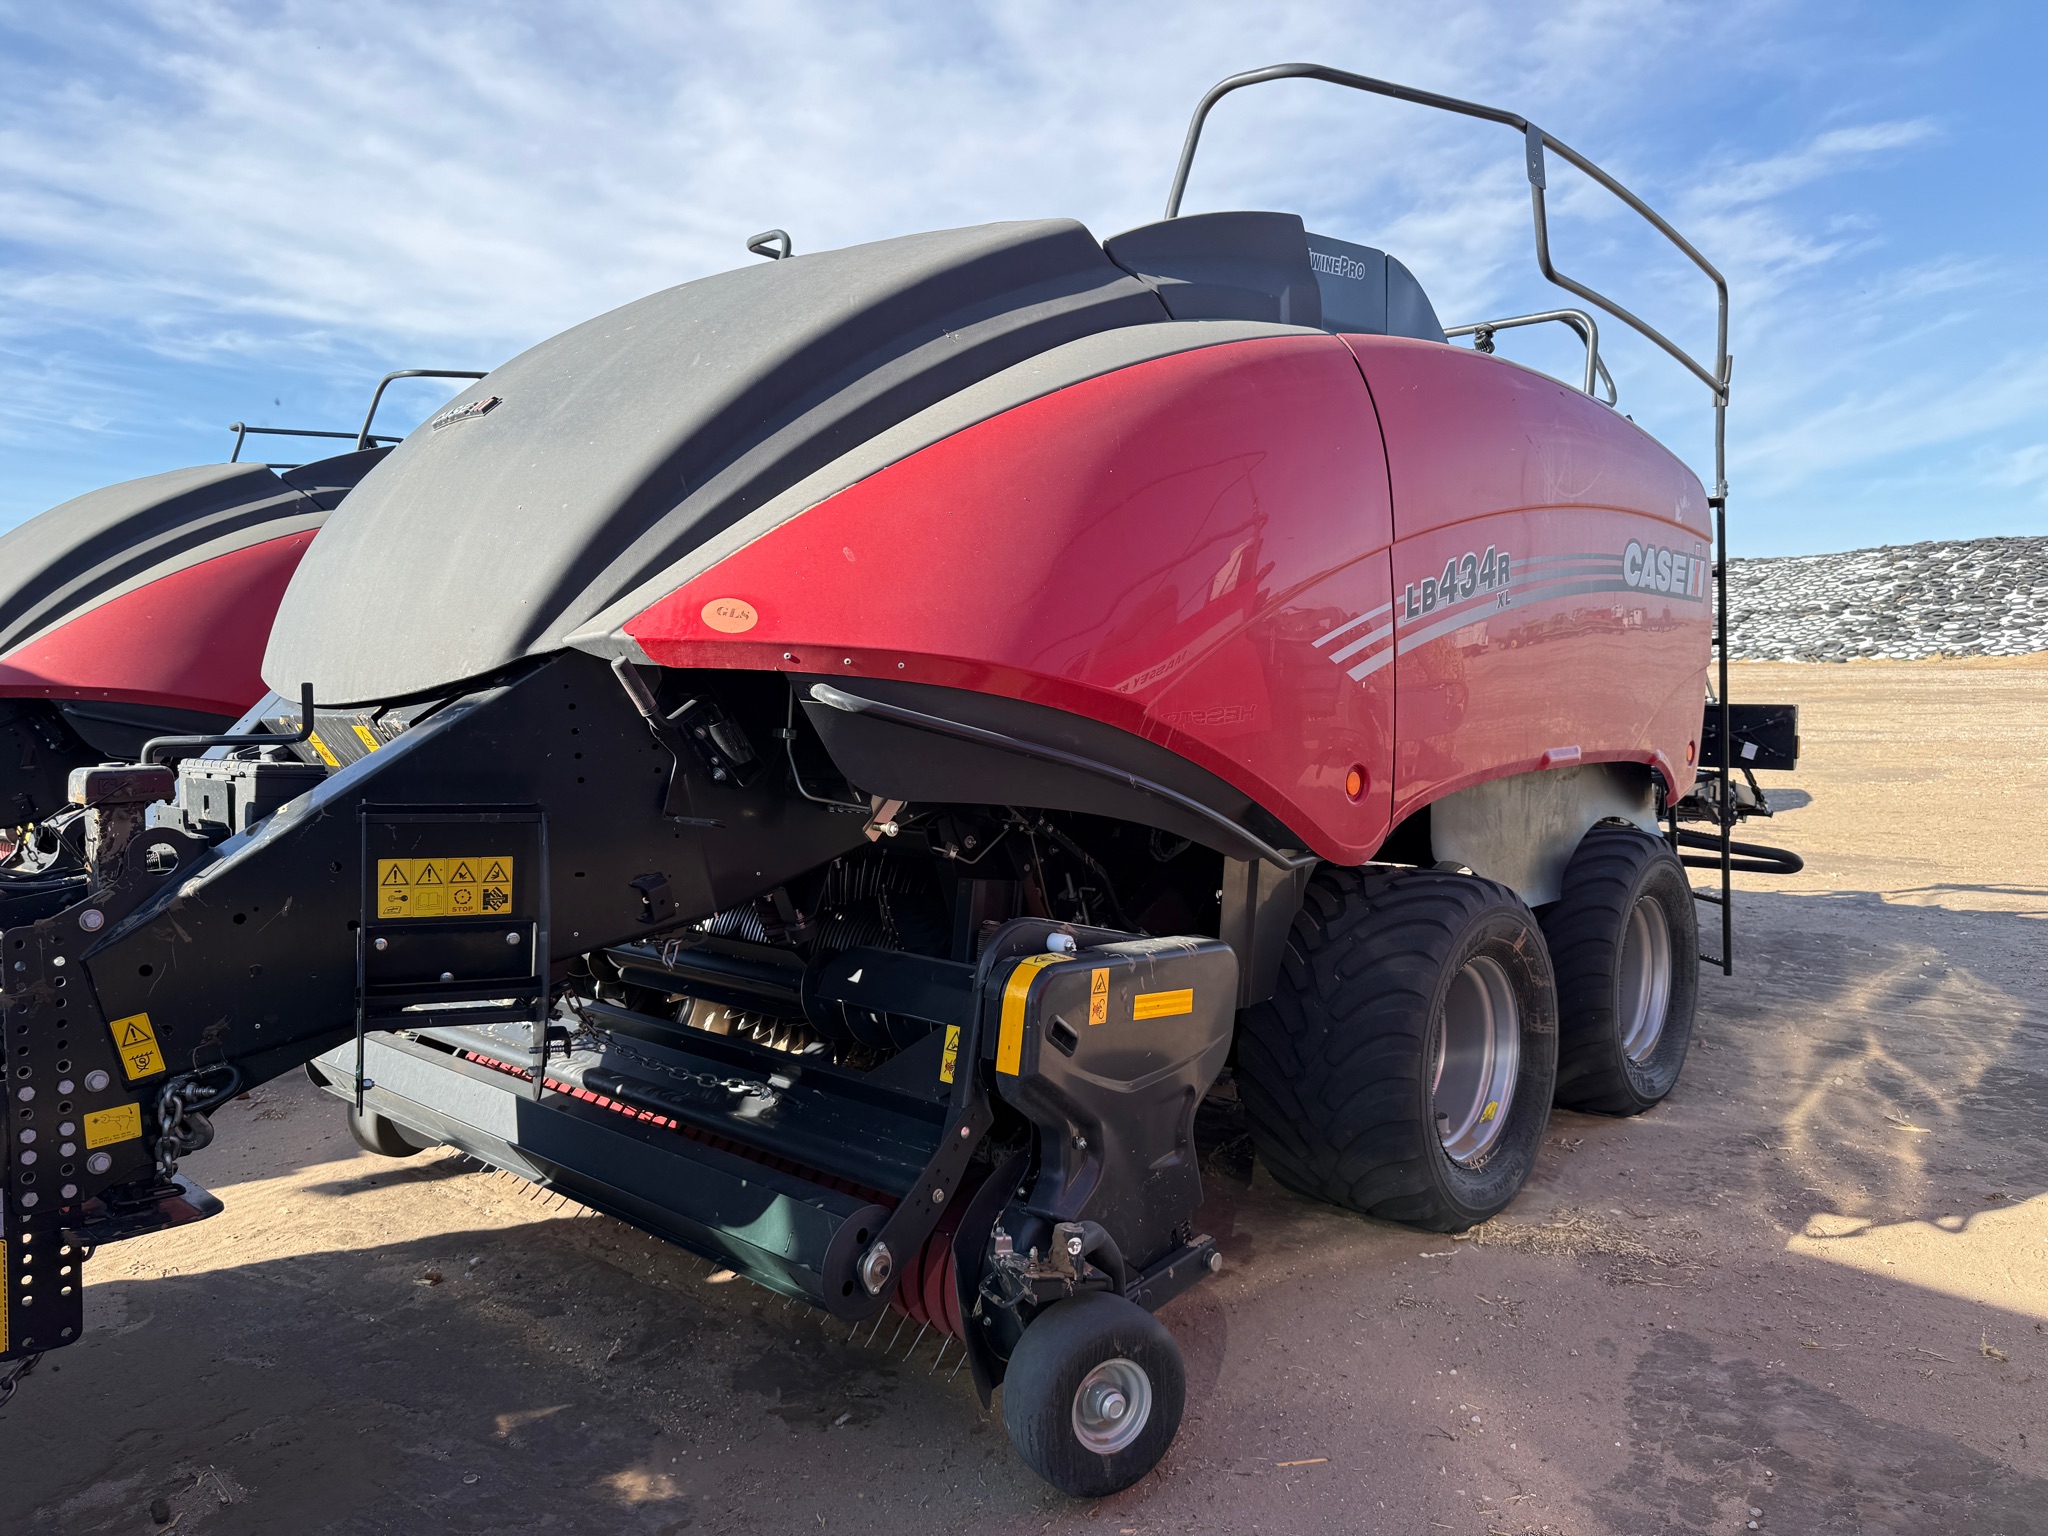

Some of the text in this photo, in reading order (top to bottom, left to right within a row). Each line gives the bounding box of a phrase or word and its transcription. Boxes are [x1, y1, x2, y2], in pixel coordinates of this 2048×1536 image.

[1404, 543, 1512, 622] LB434R
[1496, 589, 1512, 610] XL
[716, 606, 750, 621] GLS
[451, 905, 474, 913] STOP
